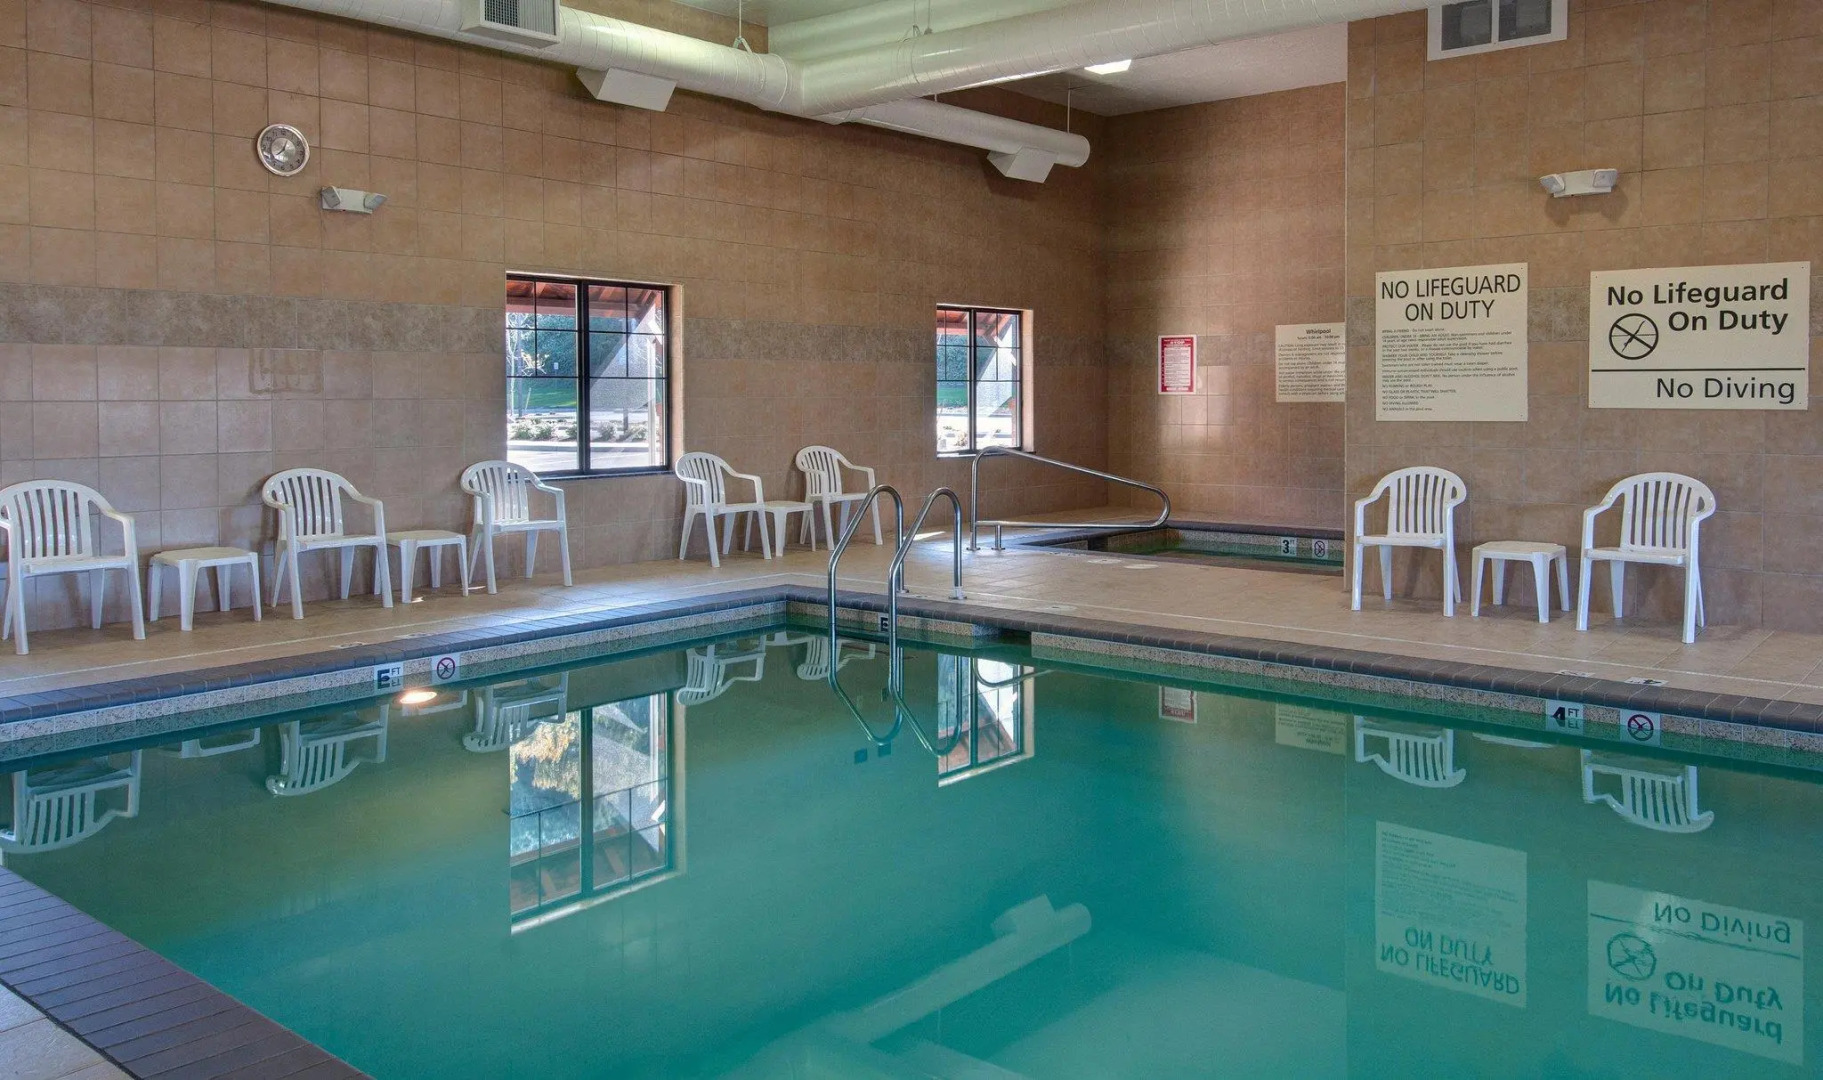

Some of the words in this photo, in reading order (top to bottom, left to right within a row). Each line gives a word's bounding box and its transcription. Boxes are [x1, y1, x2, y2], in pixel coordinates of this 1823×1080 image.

[1382, 280, 1409, 300] NO
[1417, 274, 1521, 298] LIFEGUARD
[1608, 286, 1643, 306] No
[1654, 278, 1788, 308] Lifeguard
[1405, 303, 1433, 321] ON
[1441, 300, 1495, 320] DUTY
[1668, 311, 1707, 332] On
[1720, 310, 1788, 335] Duty
[1657, 378, 1693, 398] No
[1705, 377, 1795, 404] Diving
[1568, 708, 1580, 718] FT
